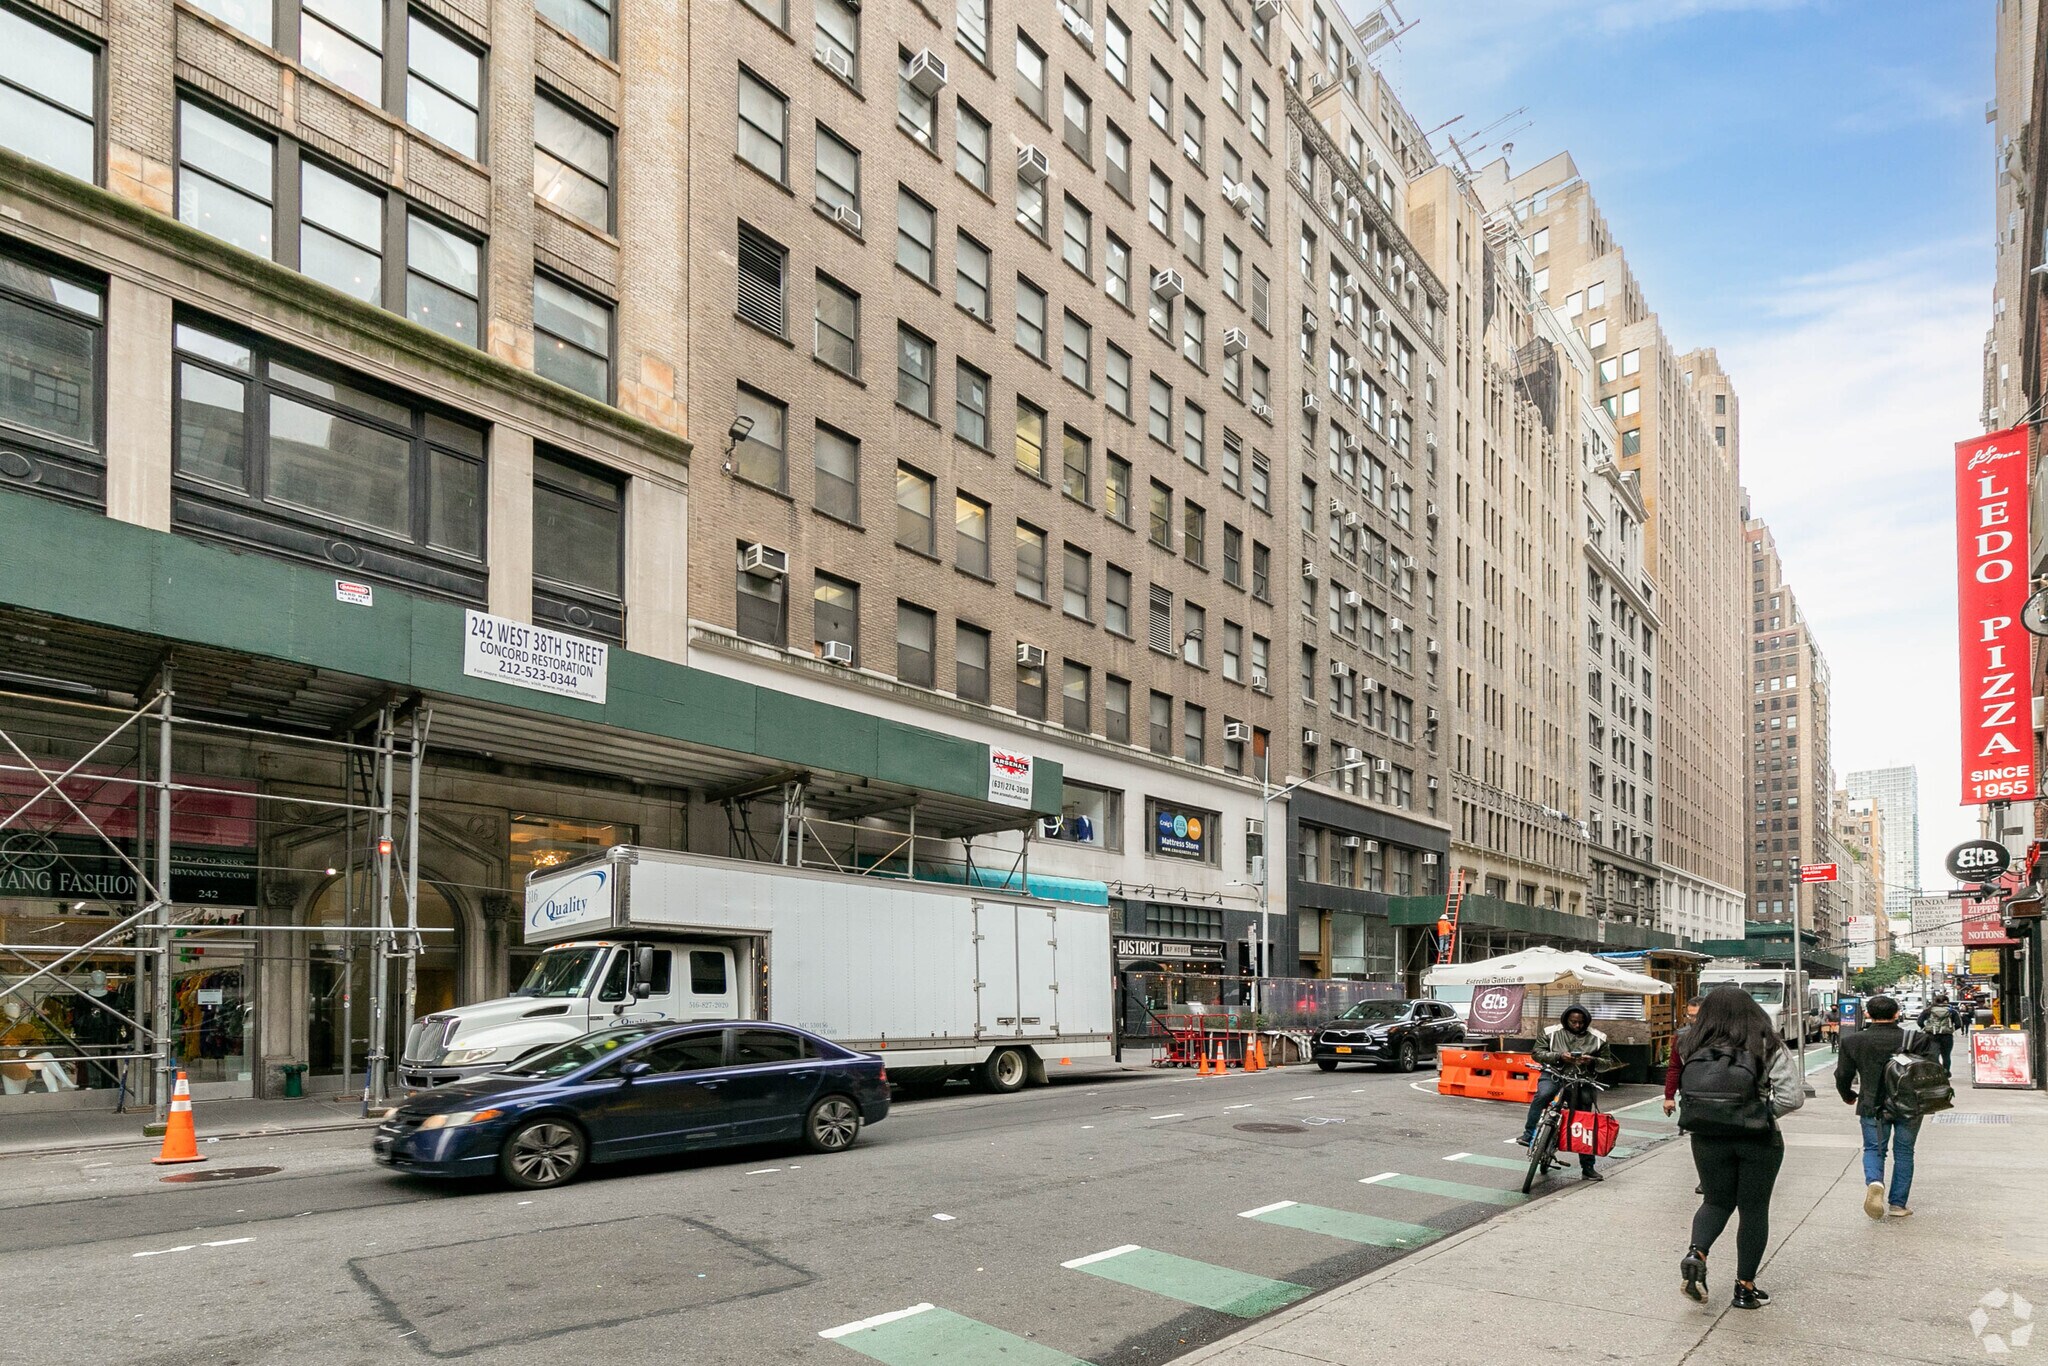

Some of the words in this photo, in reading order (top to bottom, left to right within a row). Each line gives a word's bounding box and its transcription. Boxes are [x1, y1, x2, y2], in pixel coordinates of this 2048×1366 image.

[1974, 474, 2014, 584] LEDO
[471, 616, 493, 640] 242
[498, 622, 530, 649] WEST
[533, 632, 562, 656] 38TH
[565, 640, 604, 666] STREET
[480, 641, 529, 663] CONCORD
[531, 653, 593, 678] RESTORATION
[499, 660, 577, 688] 212-523-0344
[1978, 616, 2021, 757] PIZZA
[994, 757, 1028, 771] ARSENAL
[1970, 765, 2030, 782] SINCE
[1972, 780, 2028, 799] 1955
[1161, 837, 1185, 848] Mattress
[1185, 841, 1199, 850] Store
[198, 889, 219, 899] 242
[546, 896, 588, 921] Quality
[1967, 930, 2005, 940] NOTIONS
[1982, 922, 1989, 931] &
[1118, 939, 1160, 956] DISTRICT
[1164, 945, 1173, 953] TAP
[1174, 945, 1190, 953] HOUSE
[1465, 977, 1490, 985] Estrella
[1491, 976, 1515, 984] Galicia
[1845, 1004, 1853, 1013] P
[1977, 1036, 2023, 1046] PSYCHIC
